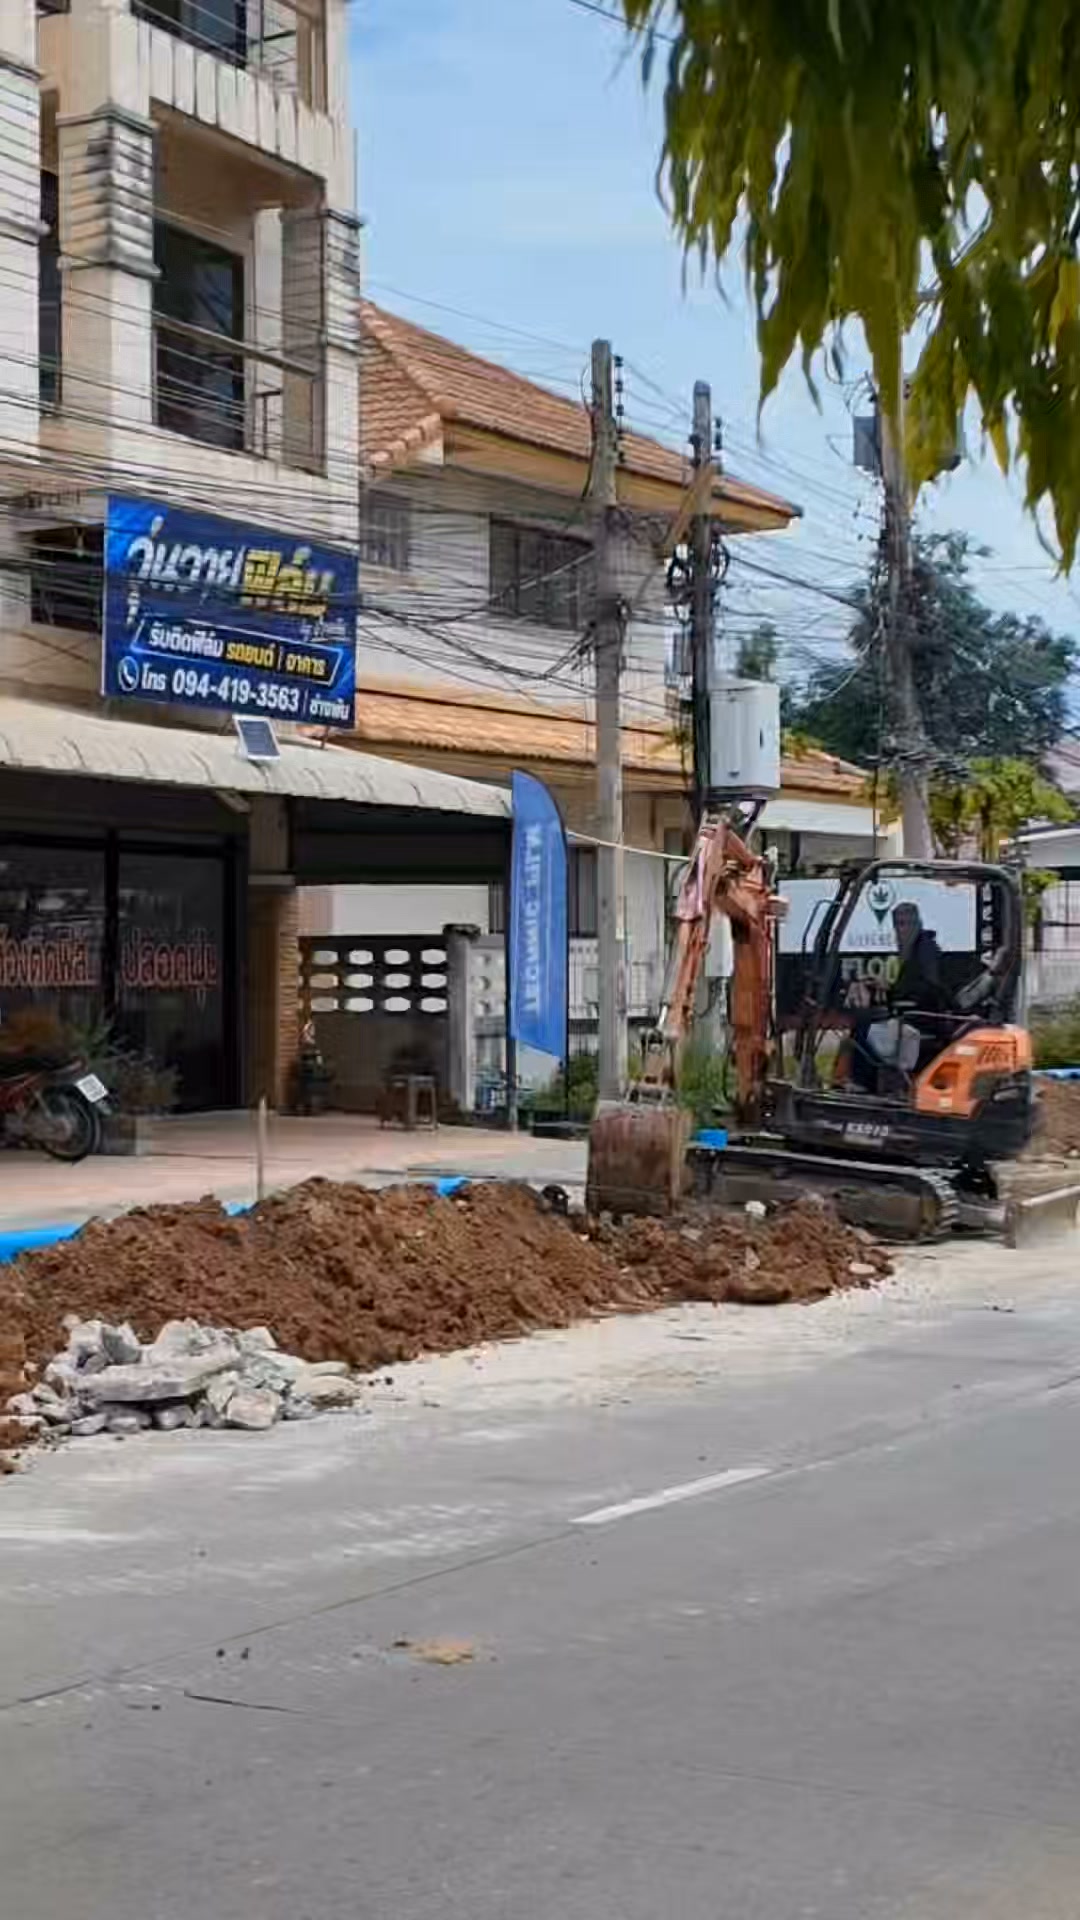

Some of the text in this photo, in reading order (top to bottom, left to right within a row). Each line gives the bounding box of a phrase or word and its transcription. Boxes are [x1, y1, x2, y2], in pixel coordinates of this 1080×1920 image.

[226, 643, 275, 668] รถยนต์
[286, 653, 326, 676] อาคาร
[141, 662, 167, 691] โทร
[172, 668, 299, 712] 094-419-3563
